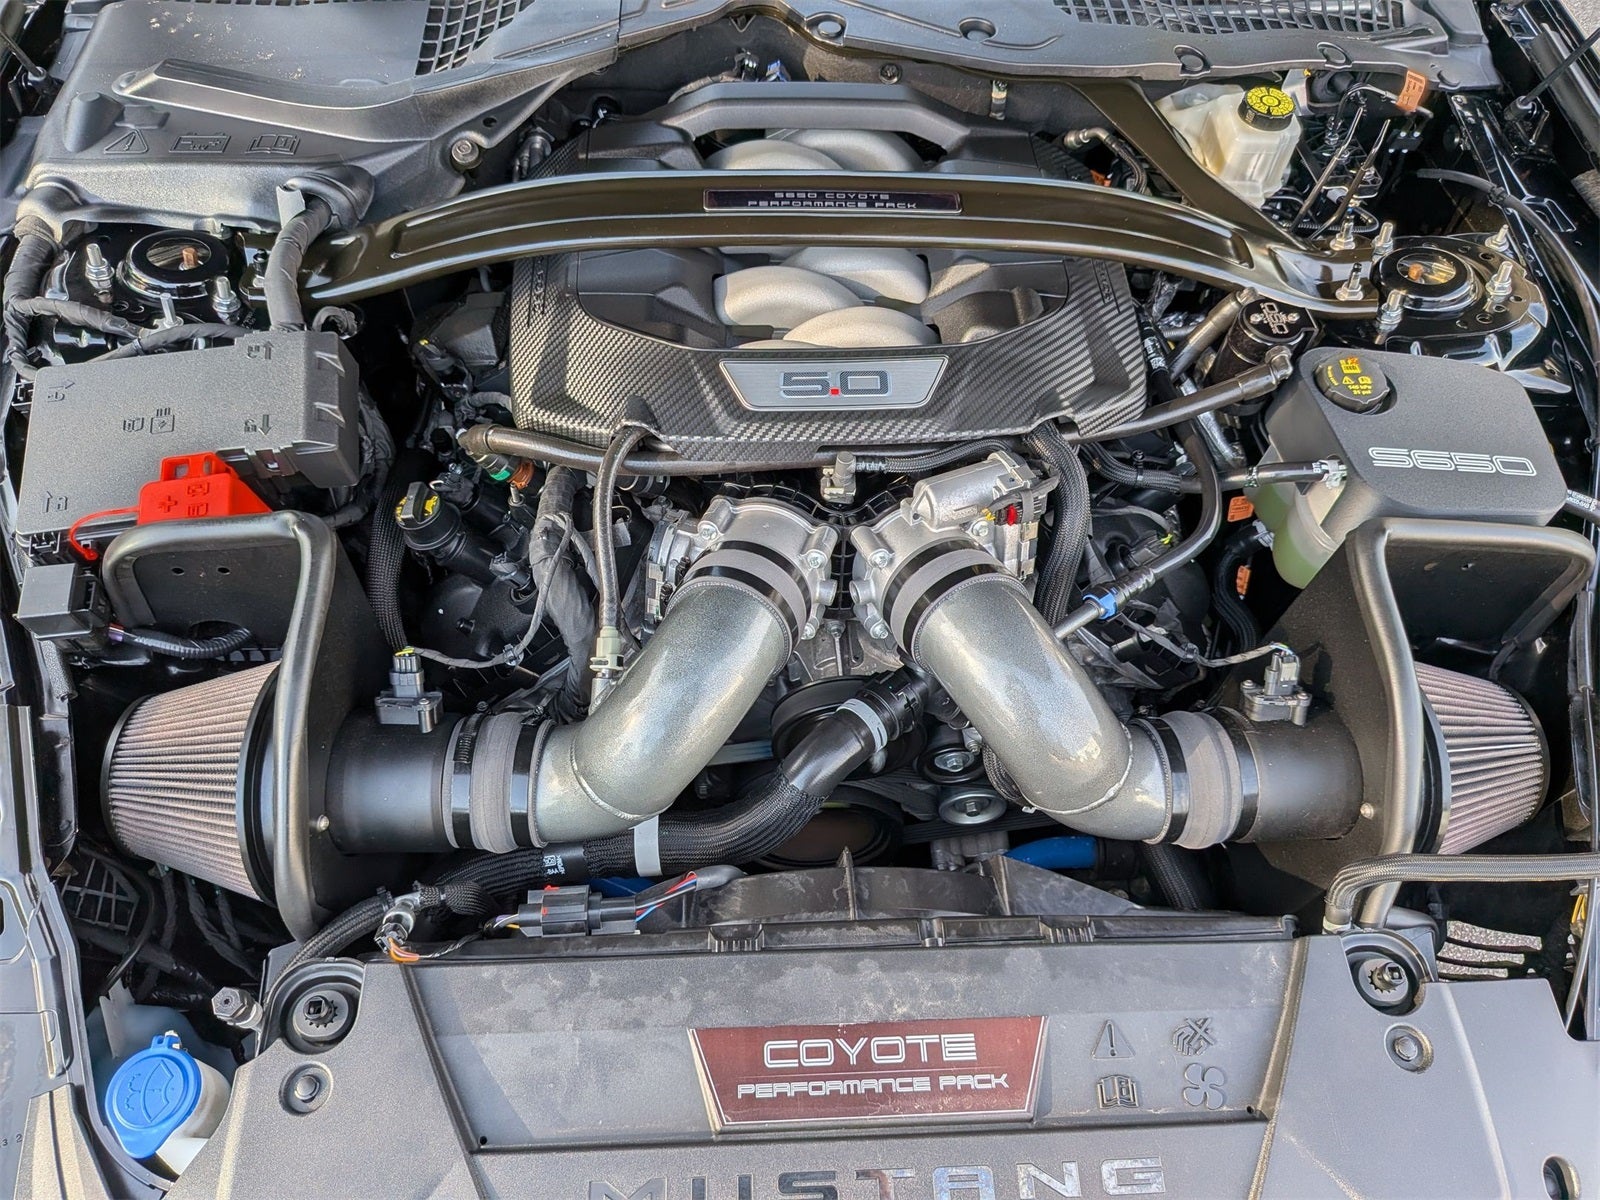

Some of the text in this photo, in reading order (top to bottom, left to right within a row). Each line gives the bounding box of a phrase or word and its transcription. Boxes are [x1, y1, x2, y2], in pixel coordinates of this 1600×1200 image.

[748, 200, 868, 208] PERFORMANCE
[780, 370, 892, 398] 5.0
[1368, 447, 1537, 476] S650
[764, 1033, 977, 1068] COYOTE
[737, 1073, 1010, 1099] PERFORMANCE PACK
[588, 1157, 1166, 1200] MUSTANG
